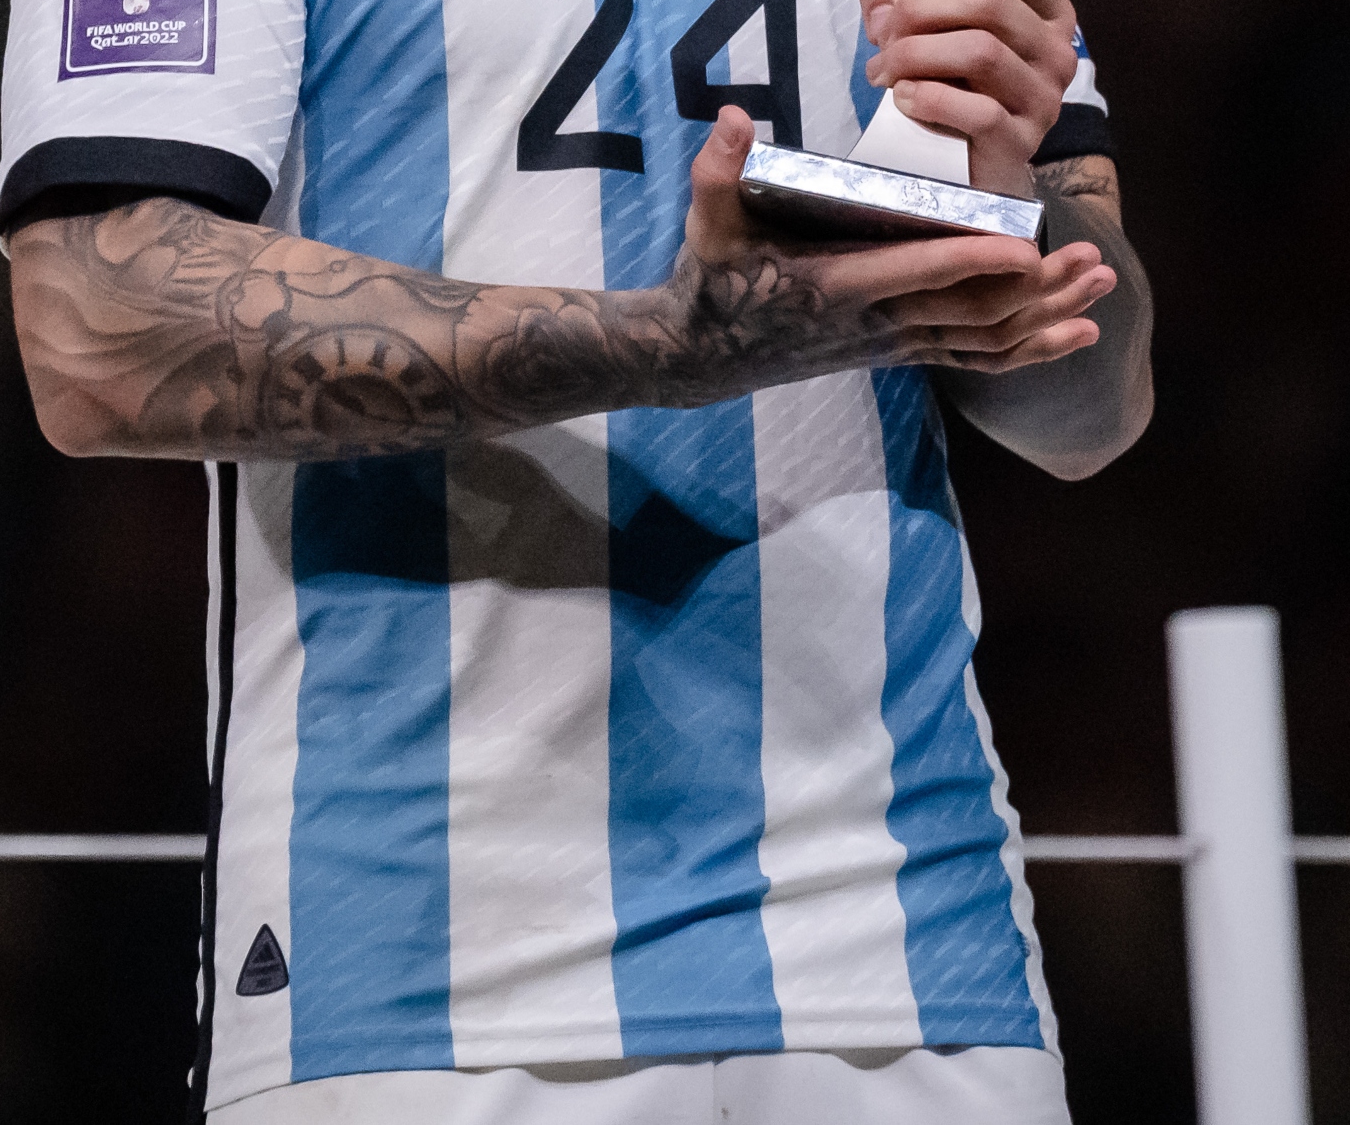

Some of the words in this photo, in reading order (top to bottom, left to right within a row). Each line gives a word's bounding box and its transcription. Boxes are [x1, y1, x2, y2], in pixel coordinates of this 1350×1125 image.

[86, 26, 113, 37] FIFA
[113, 22, 158, 34] WORLD
[160, 20, 186, 31] CUP
